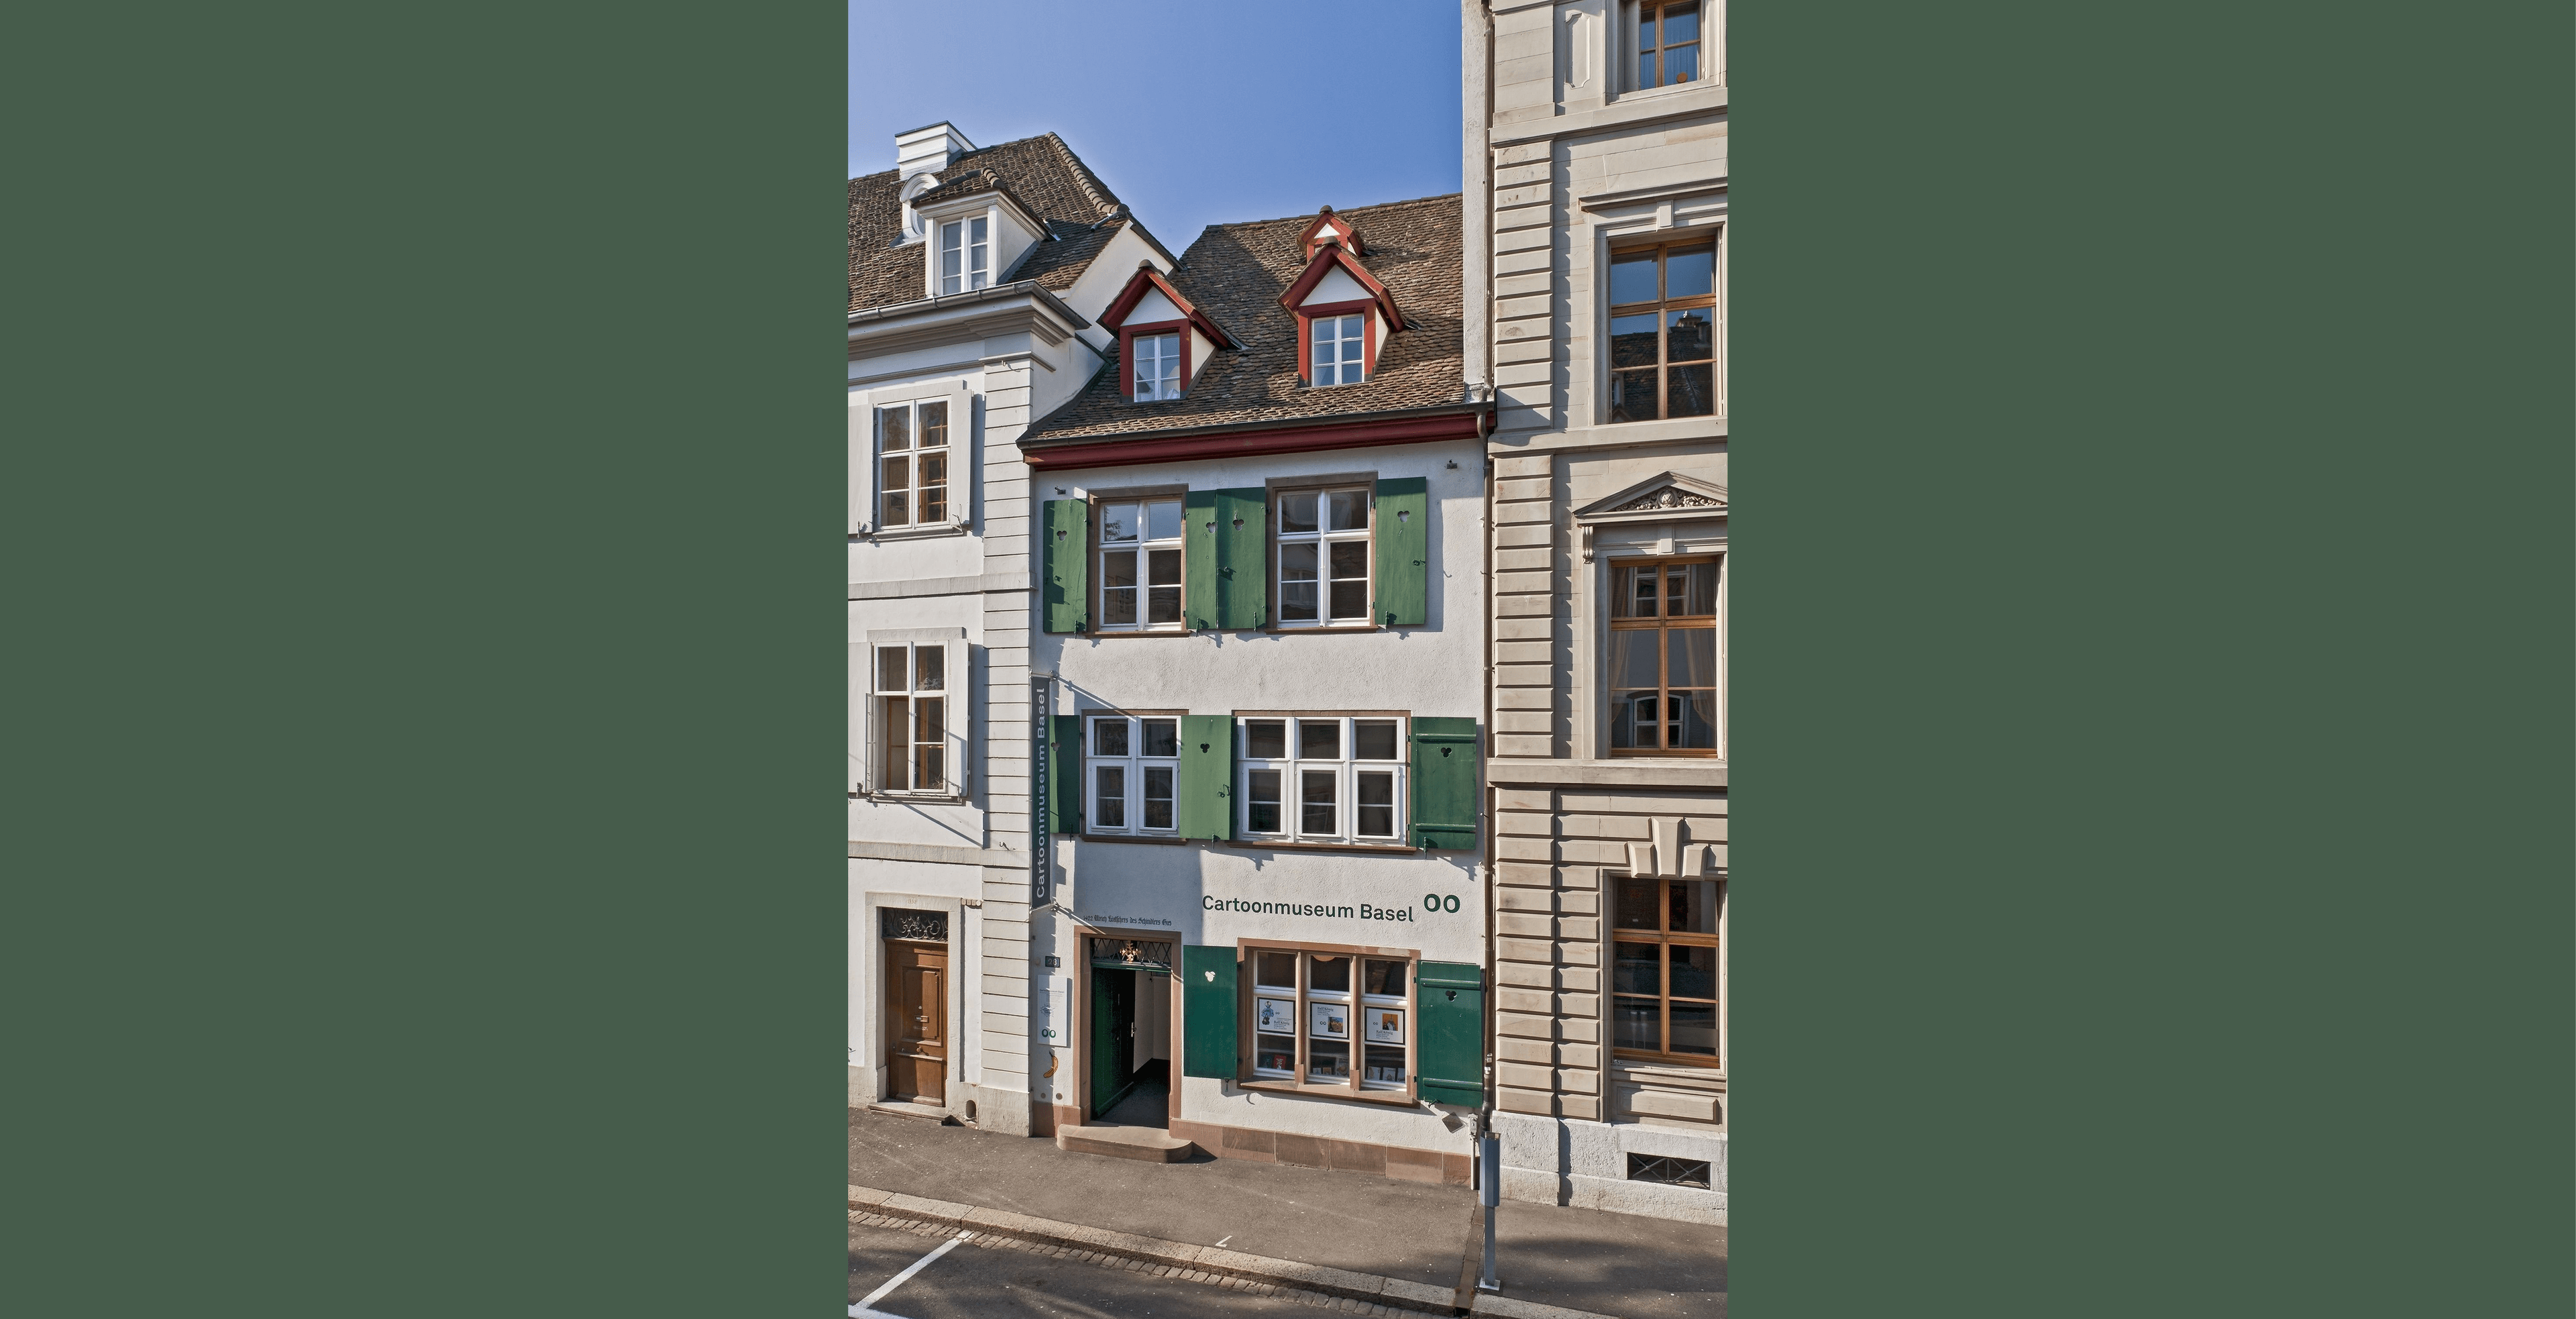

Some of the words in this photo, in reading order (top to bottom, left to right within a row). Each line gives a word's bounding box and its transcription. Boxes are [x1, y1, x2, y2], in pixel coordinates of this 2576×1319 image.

[1036, 688, 1045, 739] Basel
[1036, 744, 1045, 898] Cartoonmuseum
[1202, 895, 1354, 919] Cartoonmuseum
[1360, 903, 1414, 922] Basel
